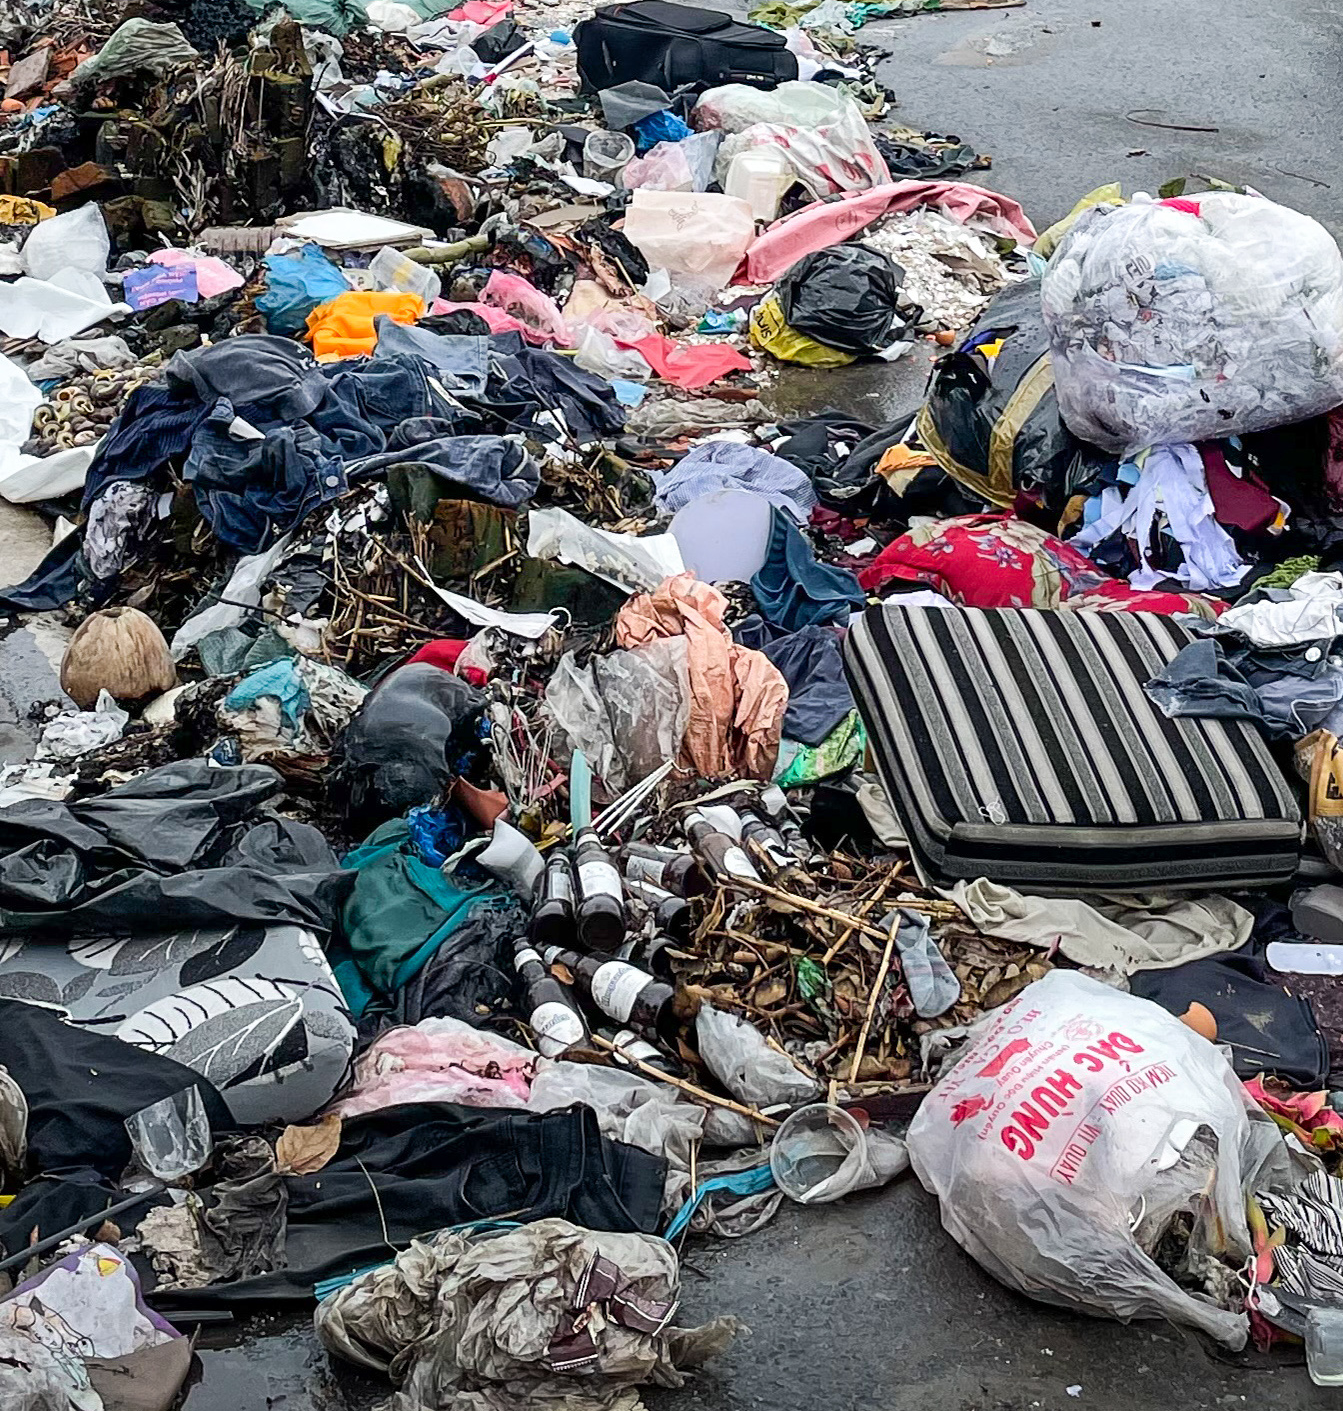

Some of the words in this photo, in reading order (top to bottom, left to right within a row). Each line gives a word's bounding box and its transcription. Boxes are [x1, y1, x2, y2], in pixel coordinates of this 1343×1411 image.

[1073, 1031, 1145, 1073] ĐẮC
[995, 1065, 1022, 1088] Quay
[1000, 1068, 1083, 1161] HÙNG
[1099, 1085, 1132, 1116] QUAY
[1056, 1143, 1087, 1185] QUAY
